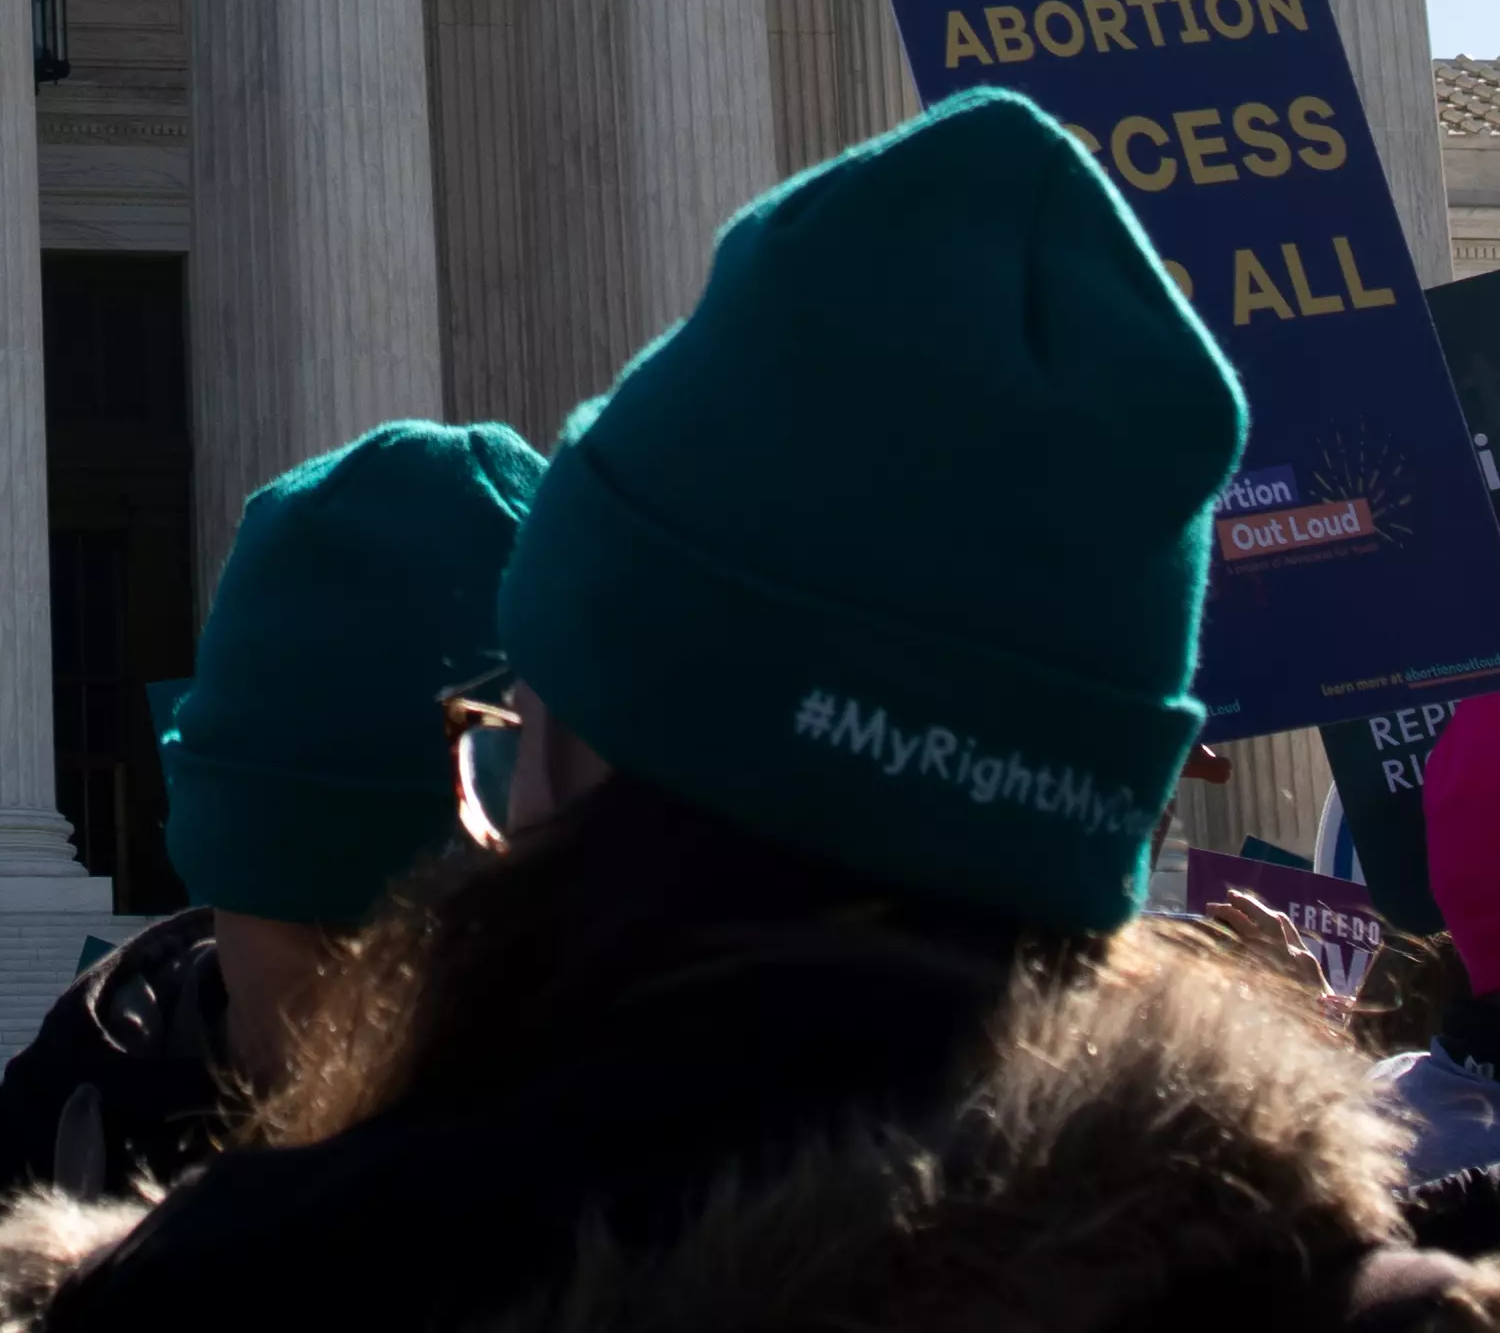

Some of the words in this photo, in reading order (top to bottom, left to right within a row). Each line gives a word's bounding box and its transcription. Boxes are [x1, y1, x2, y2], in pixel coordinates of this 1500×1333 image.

[1233, 237, 1397, 327] ALL
[1231, 523, 1288, 551] Out
[1291, 504, 1362, 543] Loud
[1320, 681, 1356, 697] learn
[1357, 676, 1388, 691] more
